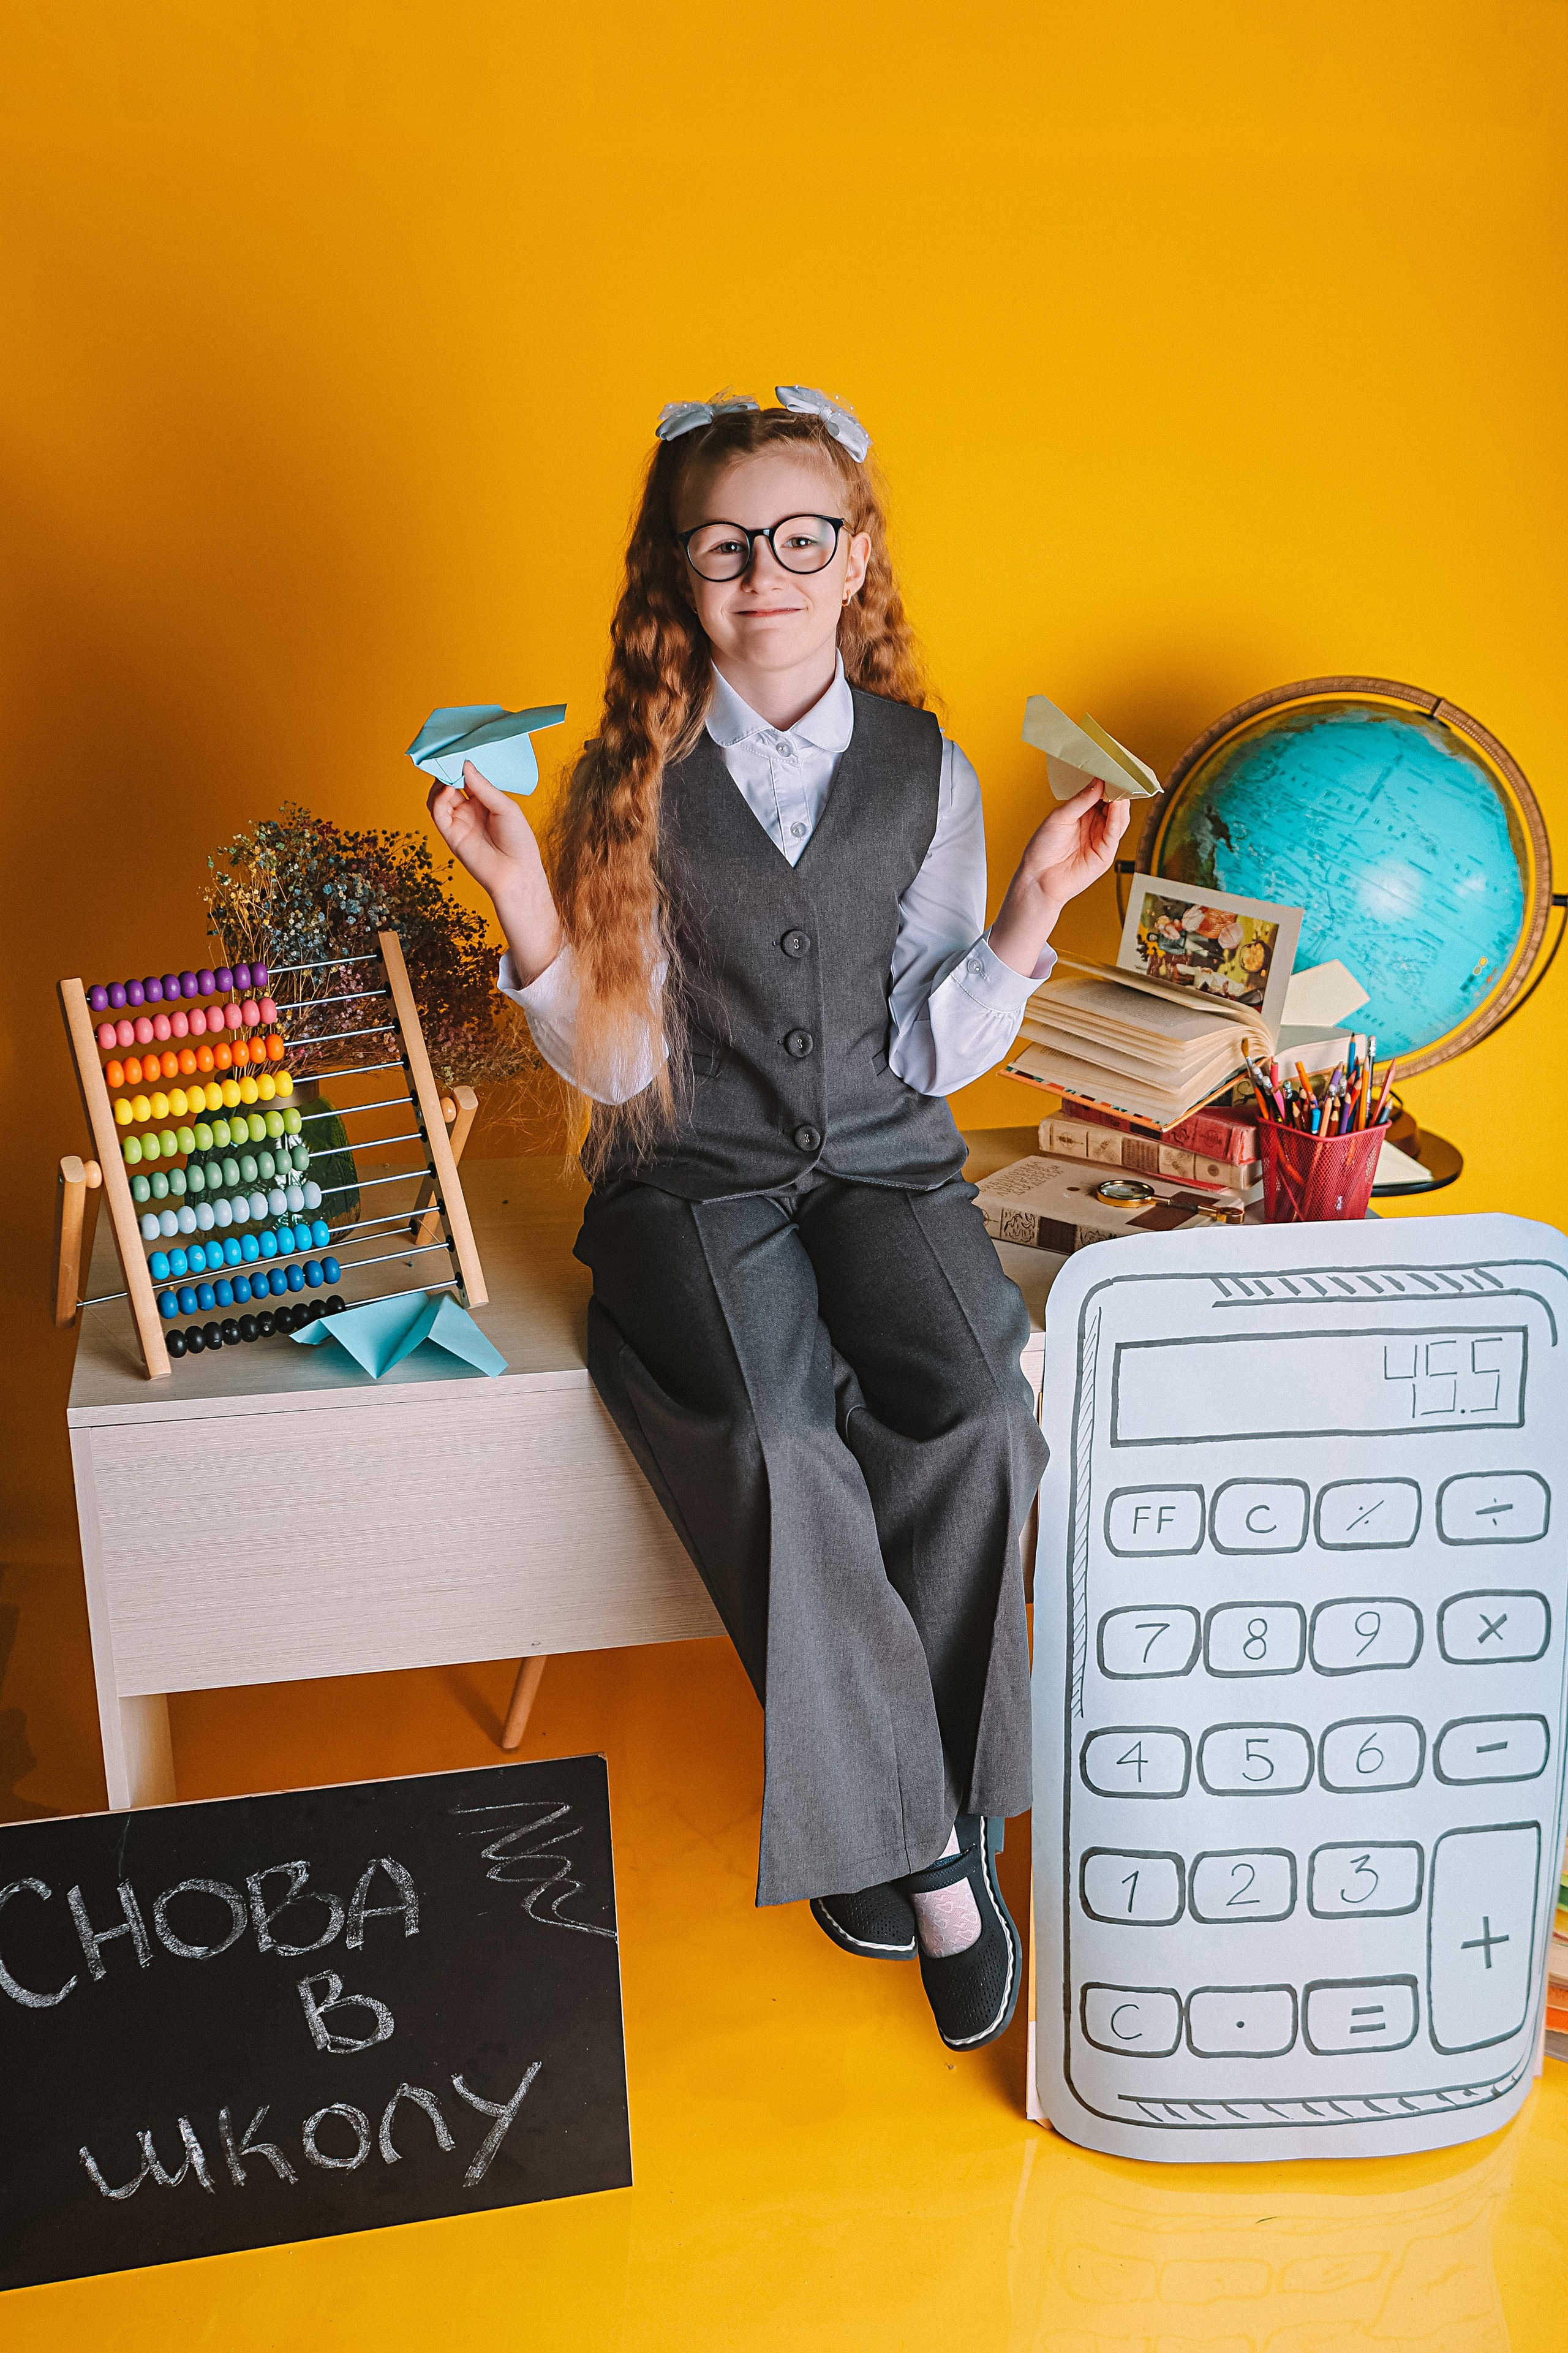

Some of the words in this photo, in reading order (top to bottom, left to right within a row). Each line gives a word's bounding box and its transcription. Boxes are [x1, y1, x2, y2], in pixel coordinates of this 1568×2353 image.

[1384, 1335, 1504, 1419] 45.5
[1133, 1505, 1177, 1535] FF
[1245, 1503, 1278, 1535] C
[1134, 1622, 1171, 1664] 7
[1242, 1617, 1269, 1661] 8
[1354, 1610, 1382, 1658] 9
[1115, 1740, 1149, 1783] 4
[1241, 1737, 1275, 1782] 5
[1355, 1732, 1385, 1774] 6
[1121, 1870, 1140, 1913] 1
[1225, 1862, 1261, 1906] 2
[1340, 1854, 1379, 1904] 3
[0, 1856, 421, 2009] СНОВА
[297, 1968, 396, 2054] В
[1109, 2003, 1144, 2041] C
[78, 2060, 543, 2200] ШКОЛУ
